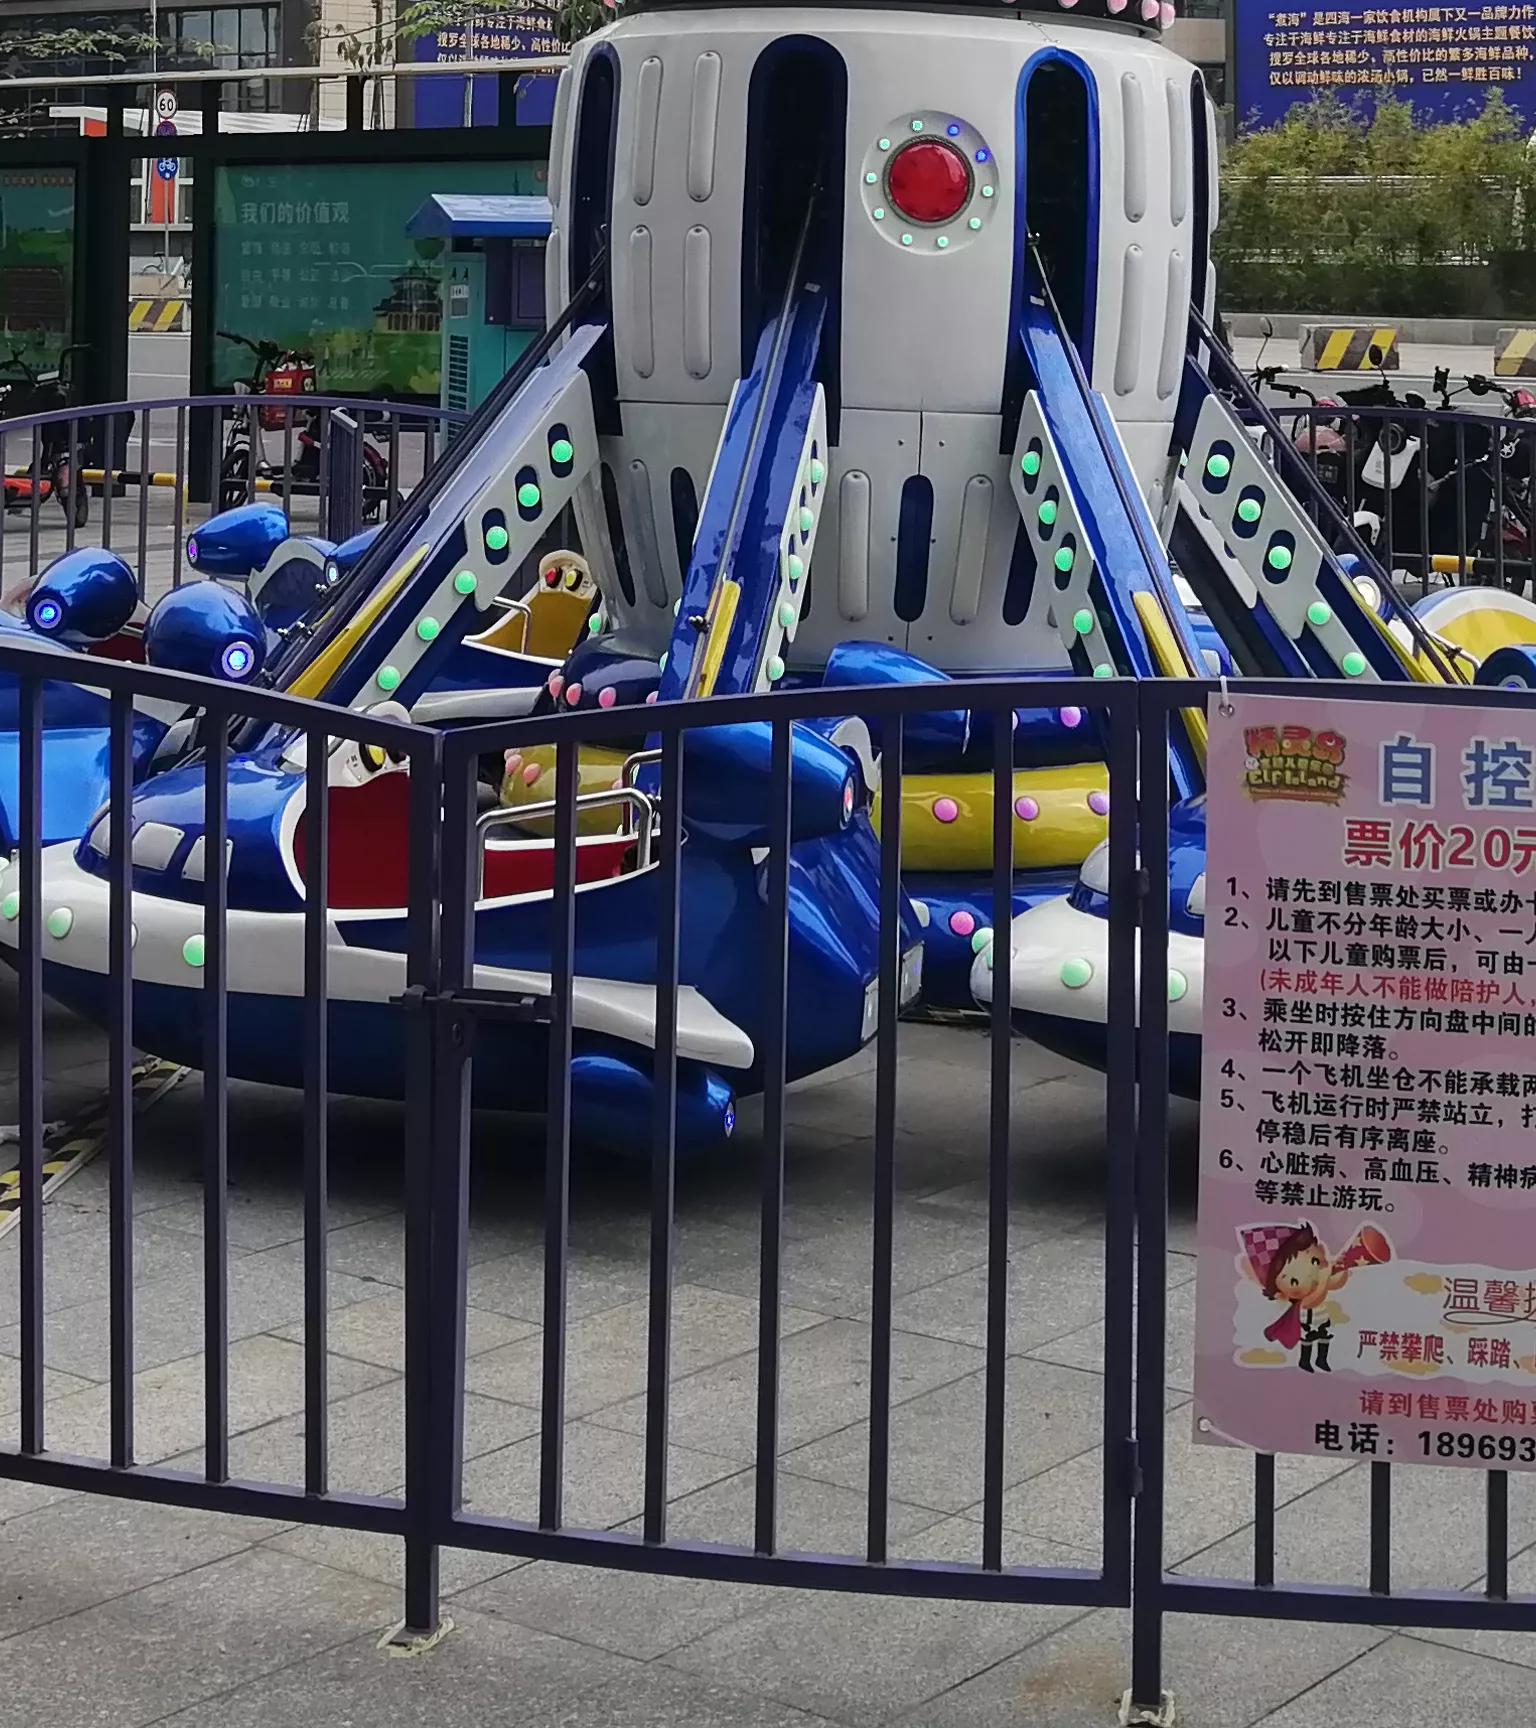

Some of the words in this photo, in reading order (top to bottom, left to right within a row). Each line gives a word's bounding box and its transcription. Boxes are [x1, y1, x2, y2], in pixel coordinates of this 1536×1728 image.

[159, 98, 174, 112] 60
[241, 201, 349, 224] 我们的价值观
[1258, 1028, 1400, 1062] 松开即降落。
[1256, 1118, 1449, 1156] 停稳后有序离座。
[1255, 1179, 1396, 1213] 等禁止游玩。
